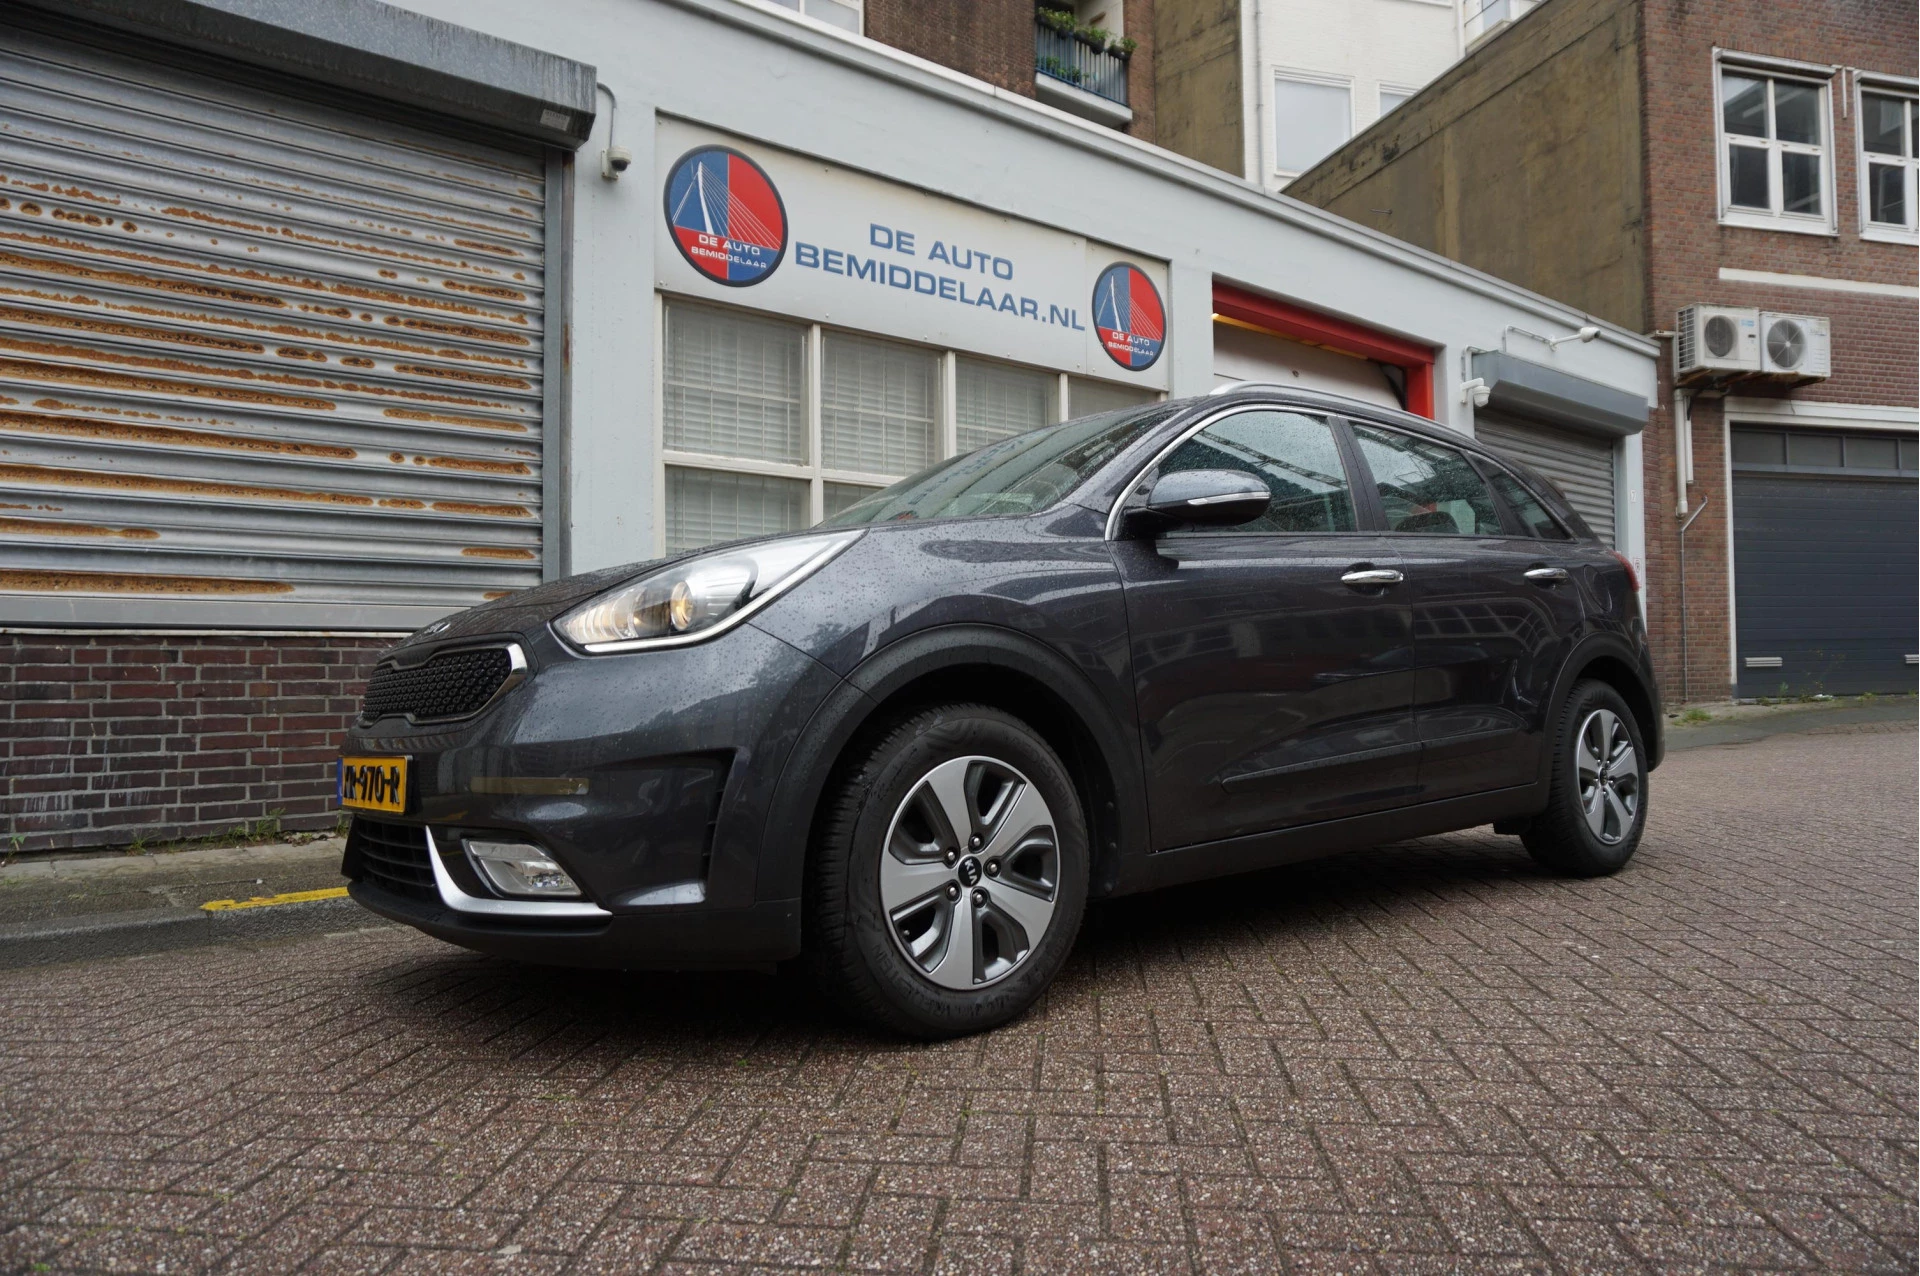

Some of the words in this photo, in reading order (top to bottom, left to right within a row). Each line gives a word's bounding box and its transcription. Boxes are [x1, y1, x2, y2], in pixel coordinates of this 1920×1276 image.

[698, 234, 718, 247] DE
[723, 240, 760, 256] AUTO
[870, 223, 915, 256] DE
[928, 240, 1013, 280] AUTO
[691, 246, 767, 269] BEMIDDELAAR
[795, 241, 1085, 331] BEMIDDELAAR.NL
[1108, 341, 1154, 356] BEMIDDELAAR
[1112, 331, 1125, 341] DE
[1127, 335, 1150, 346] AUTO
[964, 859, 978, 885] KIA
